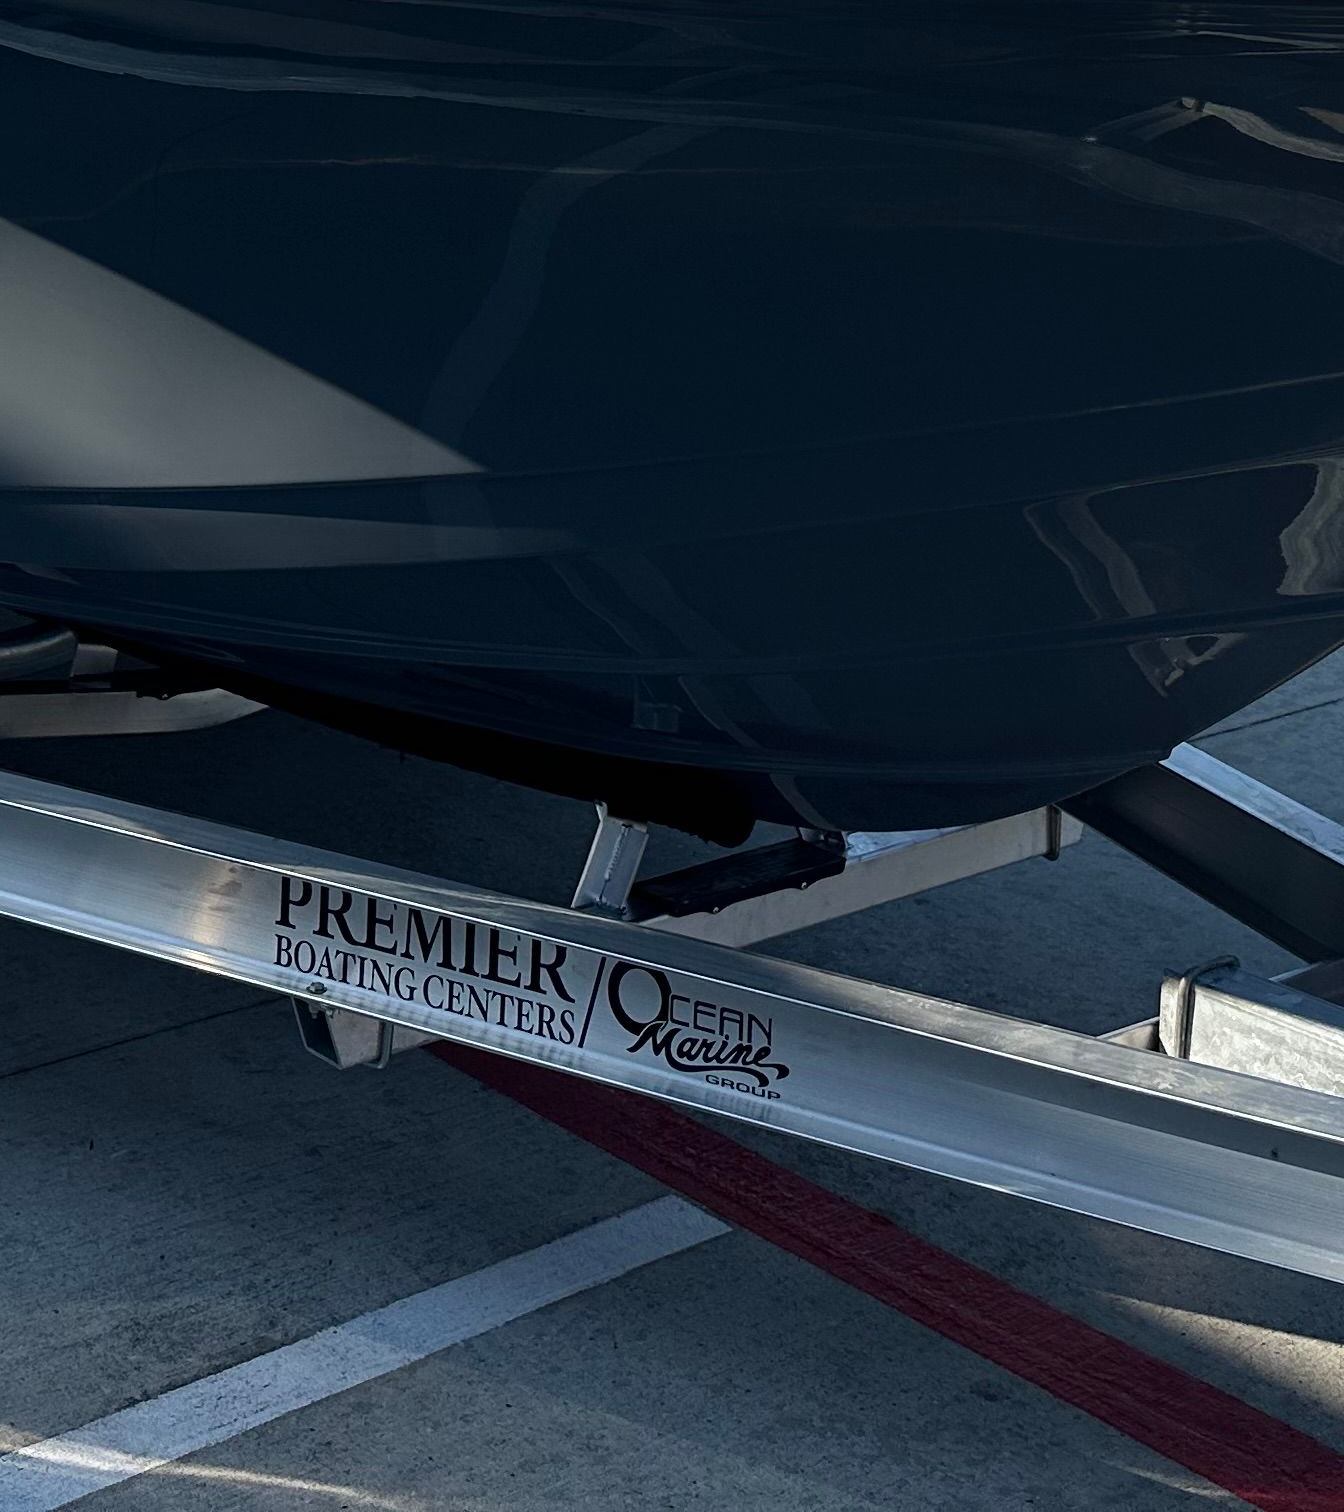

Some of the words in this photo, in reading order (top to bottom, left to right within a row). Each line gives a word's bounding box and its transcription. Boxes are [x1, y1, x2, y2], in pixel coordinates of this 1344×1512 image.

[275, 876, 575, 1003] PREMIER
[273, 934, 416, 1001] BOATING
[423, 974, 575, 1046] CENTERS
[627, 1020, 790, 1088] Marine
[705, 1074, 781, 1100] GROUP
